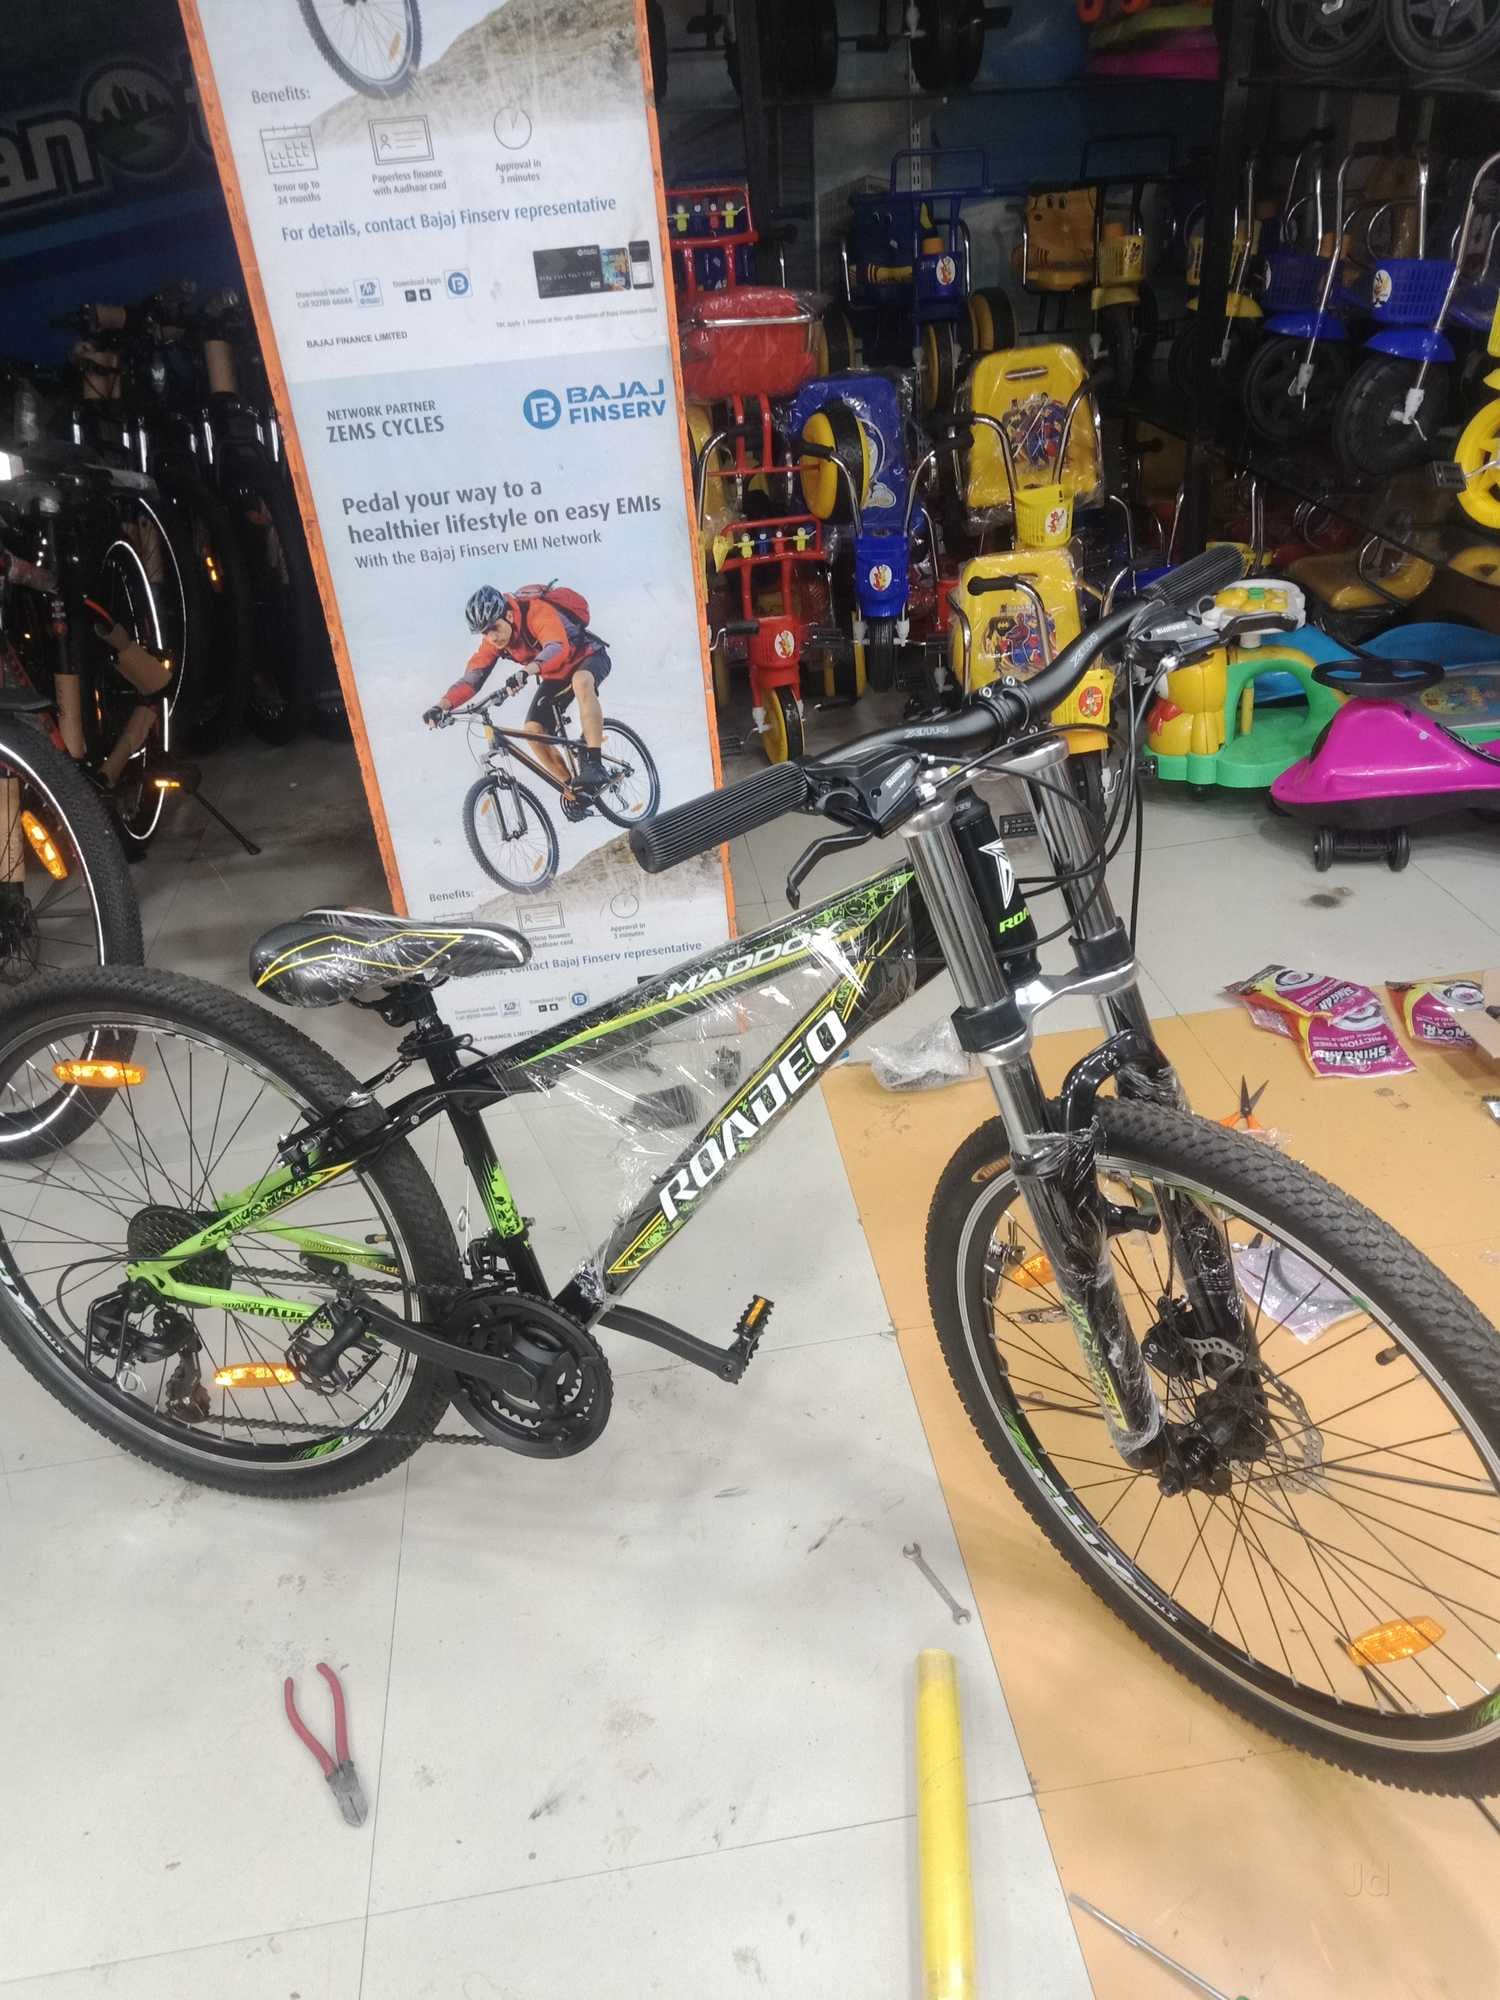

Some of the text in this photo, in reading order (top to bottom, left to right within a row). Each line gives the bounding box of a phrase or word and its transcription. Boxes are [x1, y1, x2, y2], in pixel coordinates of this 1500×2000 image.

[251, 86, 311, 105] Benefits:
[495, 159, 541, 172] Approval in
[273, 180, 320, 193] Tenor up to
[371, 168, 443, 185] Paperless finance
[499, 172, 540, 184] 3 minutes
[277, 192, 321, 206] 24 months
[373, 184, 392, 197] with
[429, 180, 447, 191] card
[281, 196, 617, 242] For details, contact Bajaj Finserv representative
[306, 330, 408, 348] BAJAJ FINANCE LIMITED
[566, 379, 665, 404] BAJAJ
[327, 400, 436, 421] NETWORK PARTNER
[569, 400, 666, 424] FINSERV
[326, 415, 445, 443] ZEMS CYCLES
[342, 481, 542, 515] Pedal your way to a
[348, 495, 661, 544] healthier lifestyle on easy EMIs
[355, 529, 602, 568] With the Bajaj Finserv EMI Network
[429, 890, 475, 903] Benefits:
[552, 957, 579, 969] Bajaj
[583, 953, 621, 965] Finserv
[624, 942, 702, 960] representative
[658, 1010, 848, 1221] ROADEO
